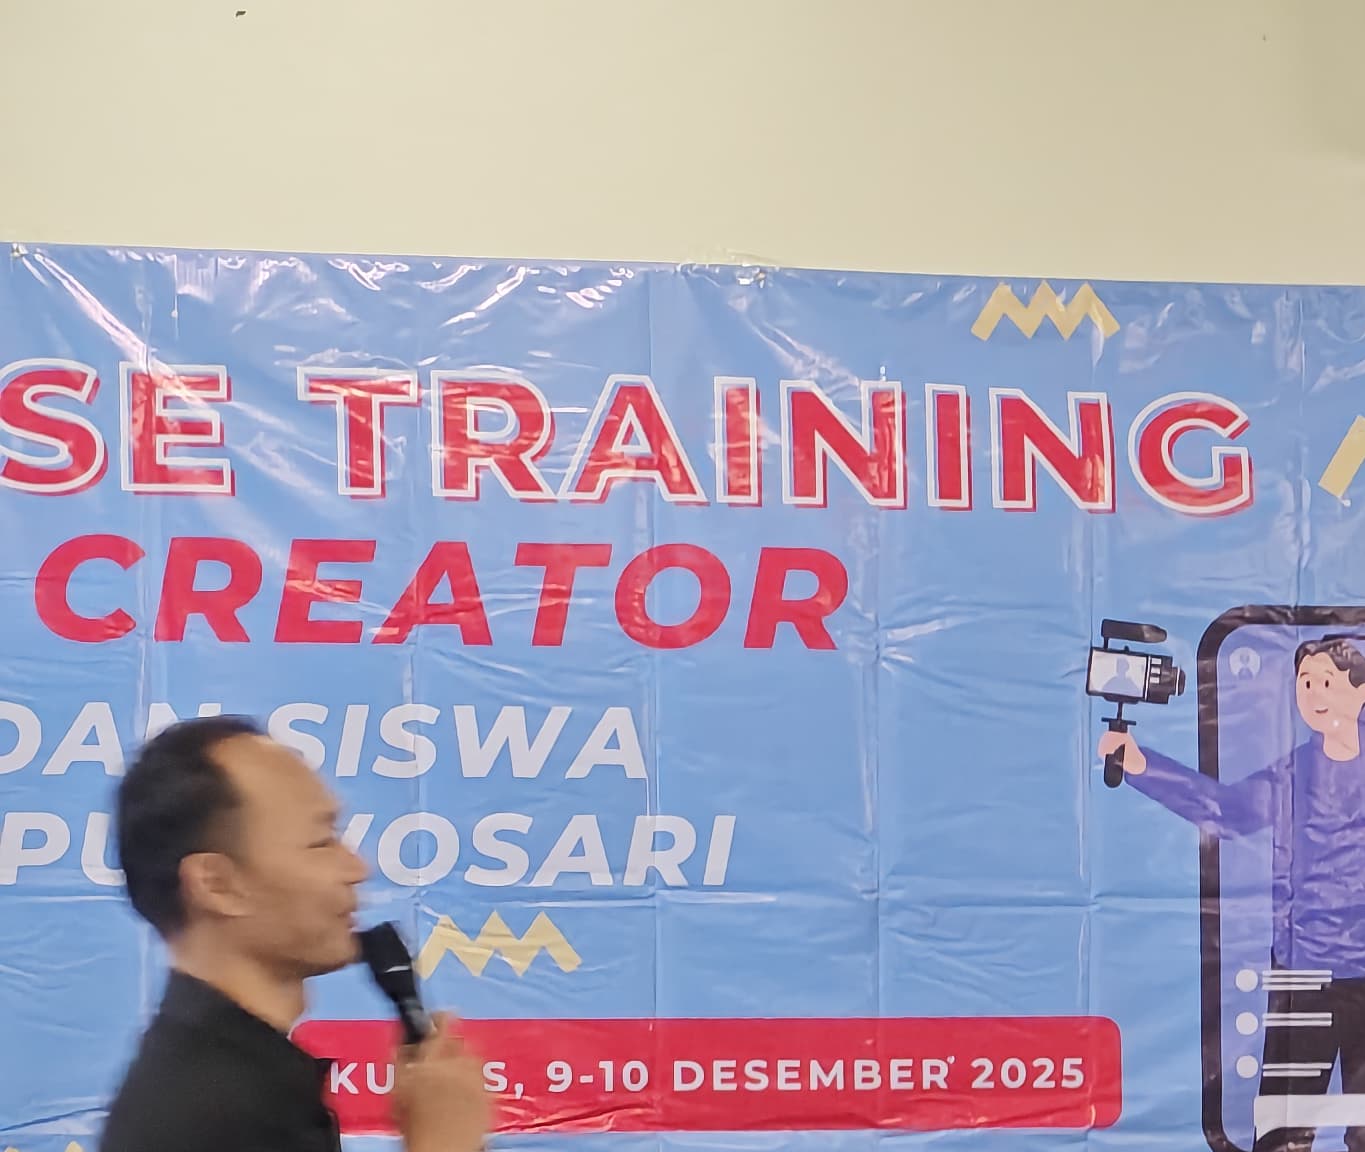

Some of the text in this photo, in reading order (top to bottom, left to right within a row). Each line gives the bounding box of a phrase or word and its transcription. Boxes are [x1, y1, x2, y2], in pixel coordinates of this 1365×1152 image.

[297, 365, 1254, 516] TRAINING
[33, 533, 849, 651] CREATOR
[330, 1057, 1086, 1098] KUS, 9-10 DESEMBER 2025
